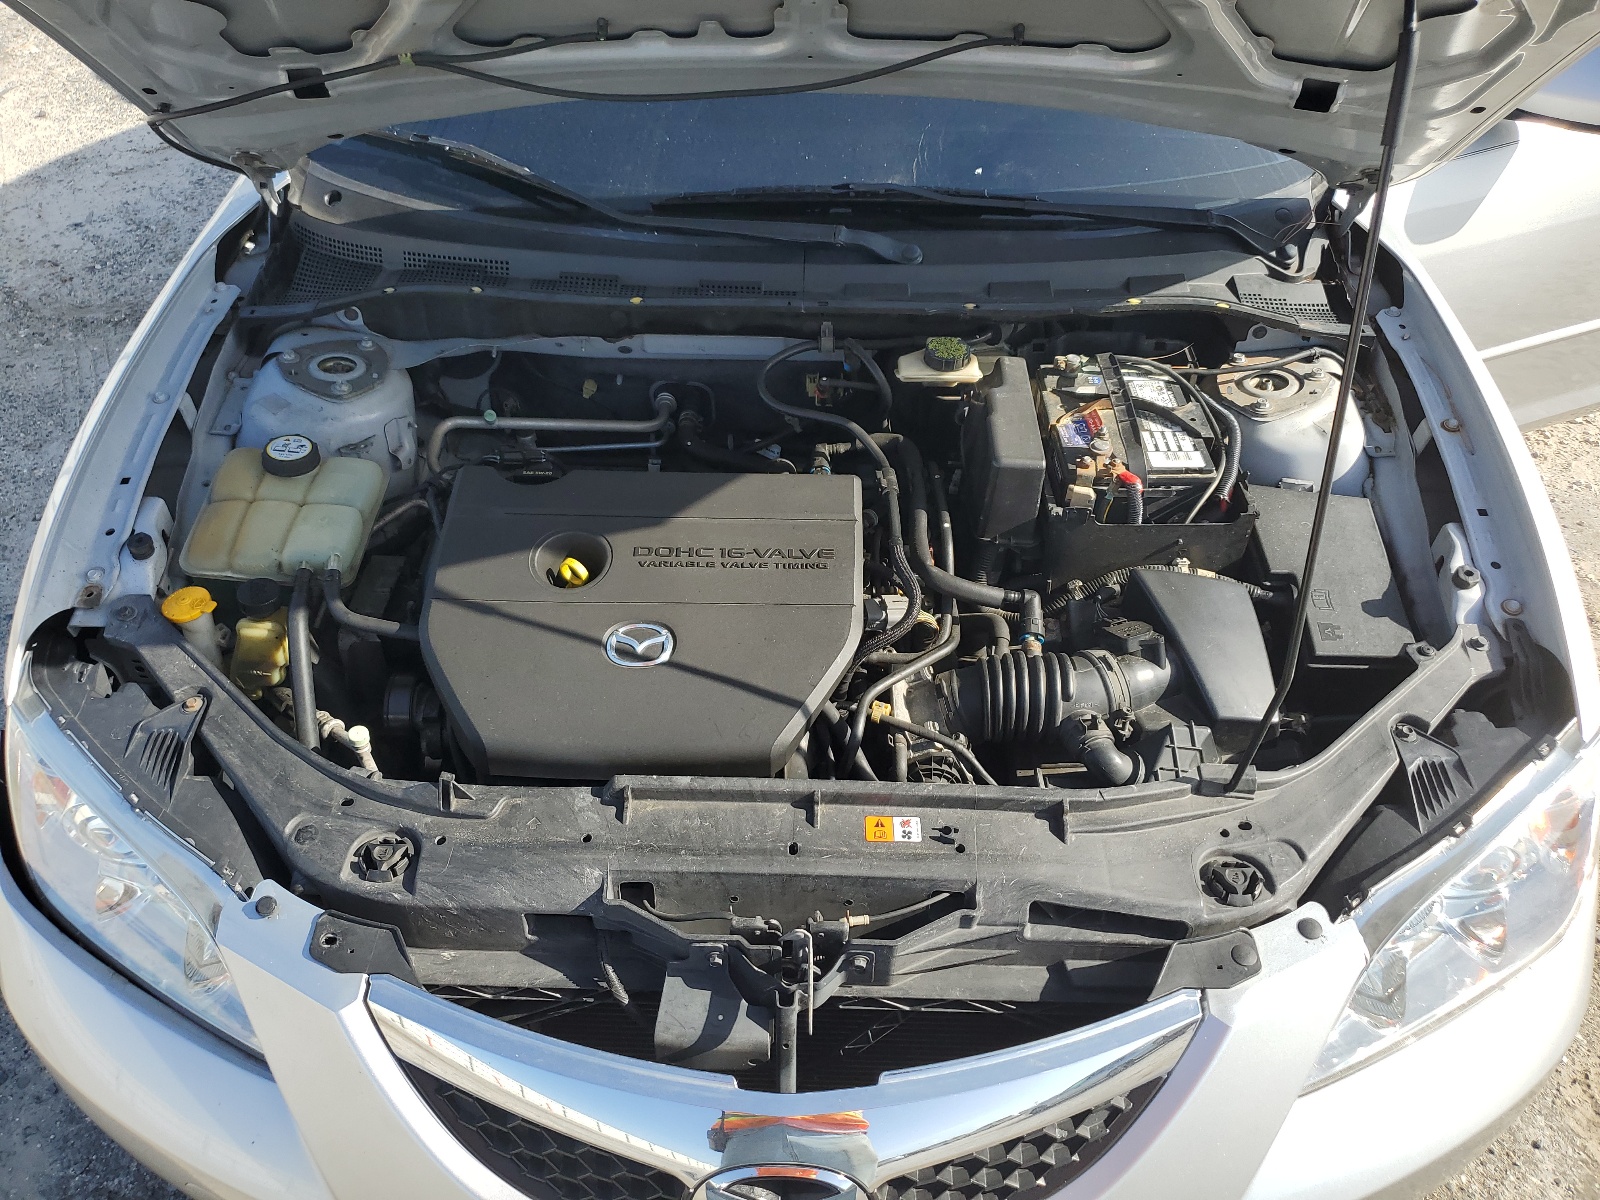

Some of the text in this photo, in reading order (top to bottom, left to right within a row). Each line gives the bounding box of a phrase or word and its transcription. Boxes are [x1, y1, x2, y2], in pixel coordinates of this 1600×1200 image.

[632, 546, 836, 560] DOHC 16-VALVE
[638, 560, 830, 570] VARIABLE VALVE TIMING
